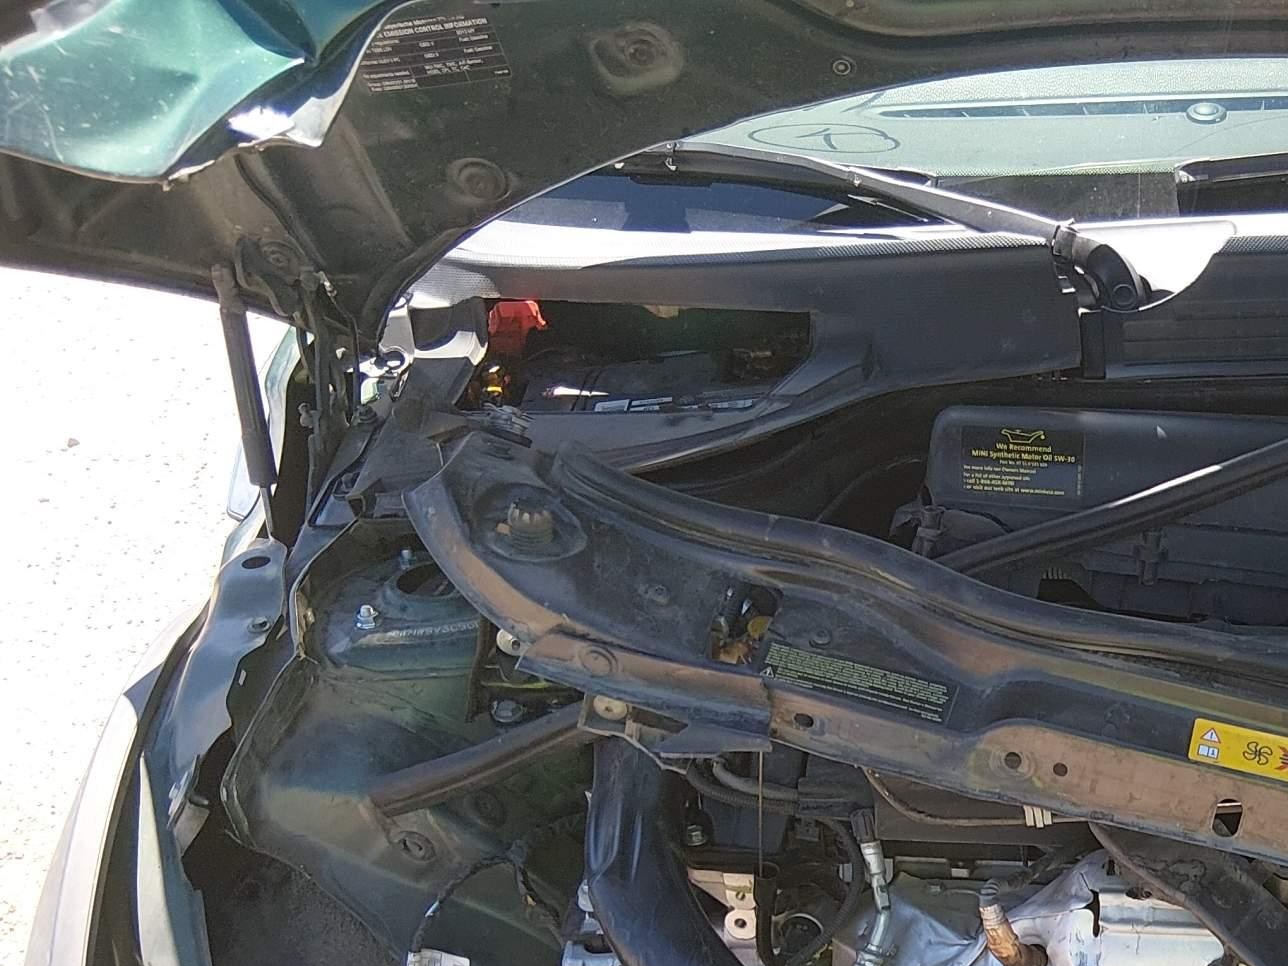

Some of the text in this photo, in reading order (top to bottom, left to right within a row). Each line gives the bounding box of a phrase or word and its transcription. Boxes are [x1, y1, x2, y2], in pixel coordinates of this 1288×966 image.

[414, 24, 444, 35] CONTROL
[1009, 443, 1052, 453] Recommend
[971, 449, 989, 457] MINI
[989, 451, 1020, 460] Synthetic
